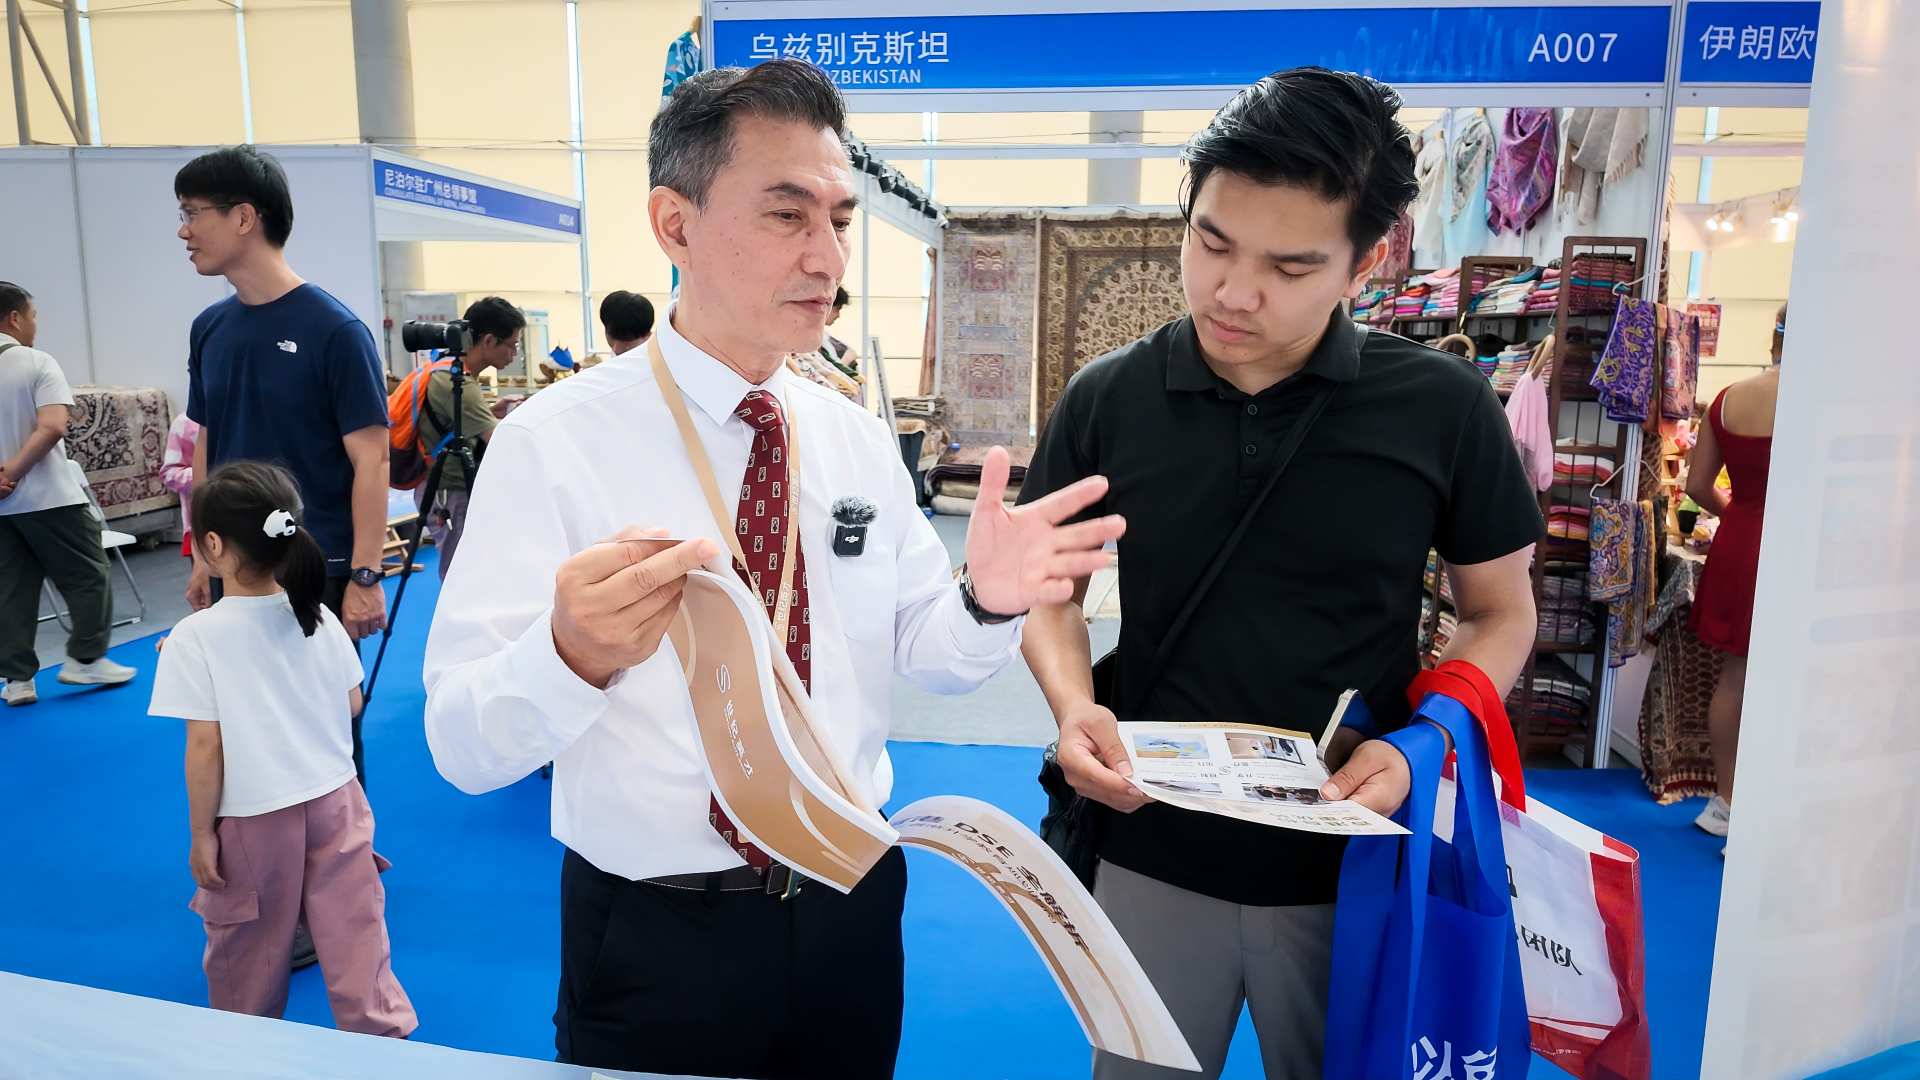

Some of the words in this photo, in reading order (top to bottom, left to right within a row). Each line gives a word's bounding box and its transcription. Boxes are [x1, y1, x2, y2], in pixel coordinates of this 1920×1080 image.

[749, 30, 949, 65] 乌兹别克斯坦
[1528, 33, 1618, 63] A007
[1699, 24, 1816, 60] 伊朗欧
[954, 822, 1015, 859] DSE
[1516, 924, 1583, 976] 团队
